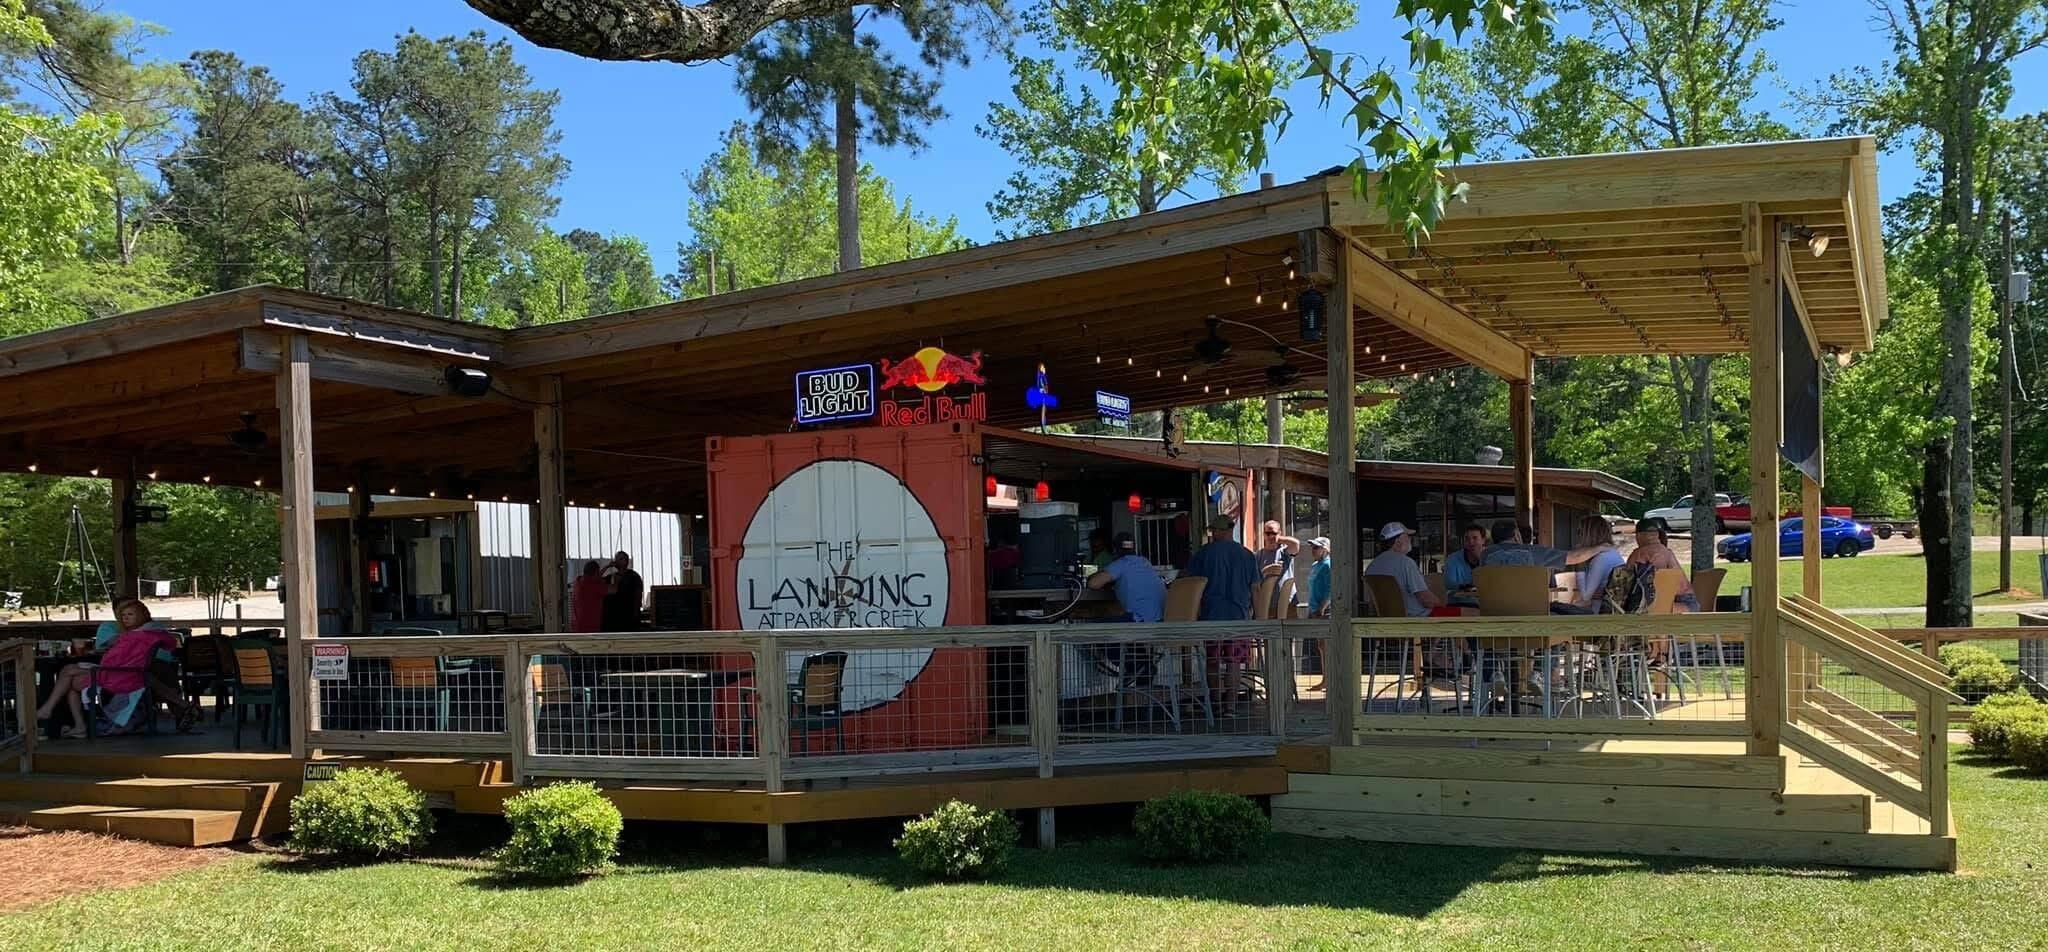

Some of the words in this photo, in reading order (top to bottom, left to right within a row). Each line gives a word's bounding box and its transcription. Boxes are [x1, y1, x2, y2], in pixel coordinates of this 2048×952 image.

[809, 371, 860, 395] BUD
[800, 391, 869, 417] LIGHT
[881, 396, 931, 427] Red
[937, 392, 987, 421] Bull
[816, 541, 856, 562] THE
[748, 573, 932, 610] LANDING
[759, 612, 783, 630] AT
[785, 611, 861, 630] PARKER
[865, 610, 927, 629] CREEK
[316, 647, 345, 655] WARNING
